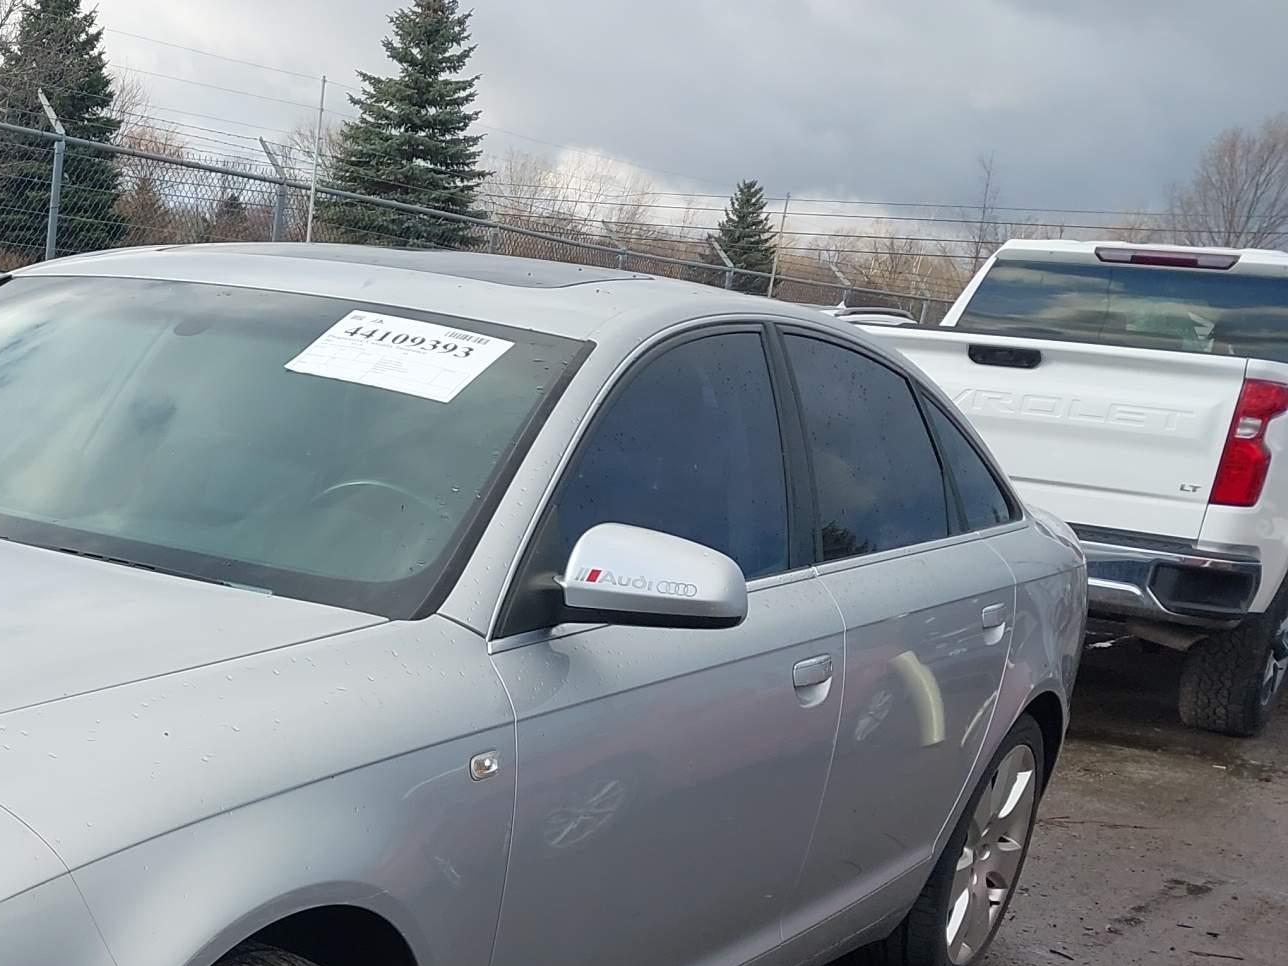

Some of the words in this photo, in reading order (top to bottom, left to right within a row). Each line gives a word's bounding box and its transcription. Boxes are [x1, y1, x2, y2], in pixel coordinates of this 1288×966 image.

[344, 326, 474, 358] 44109393
[953, 388, 1195, 431] ROLET
[1179, 483, 1201, 493] LT
[599, 570, 653, 591] Audi
